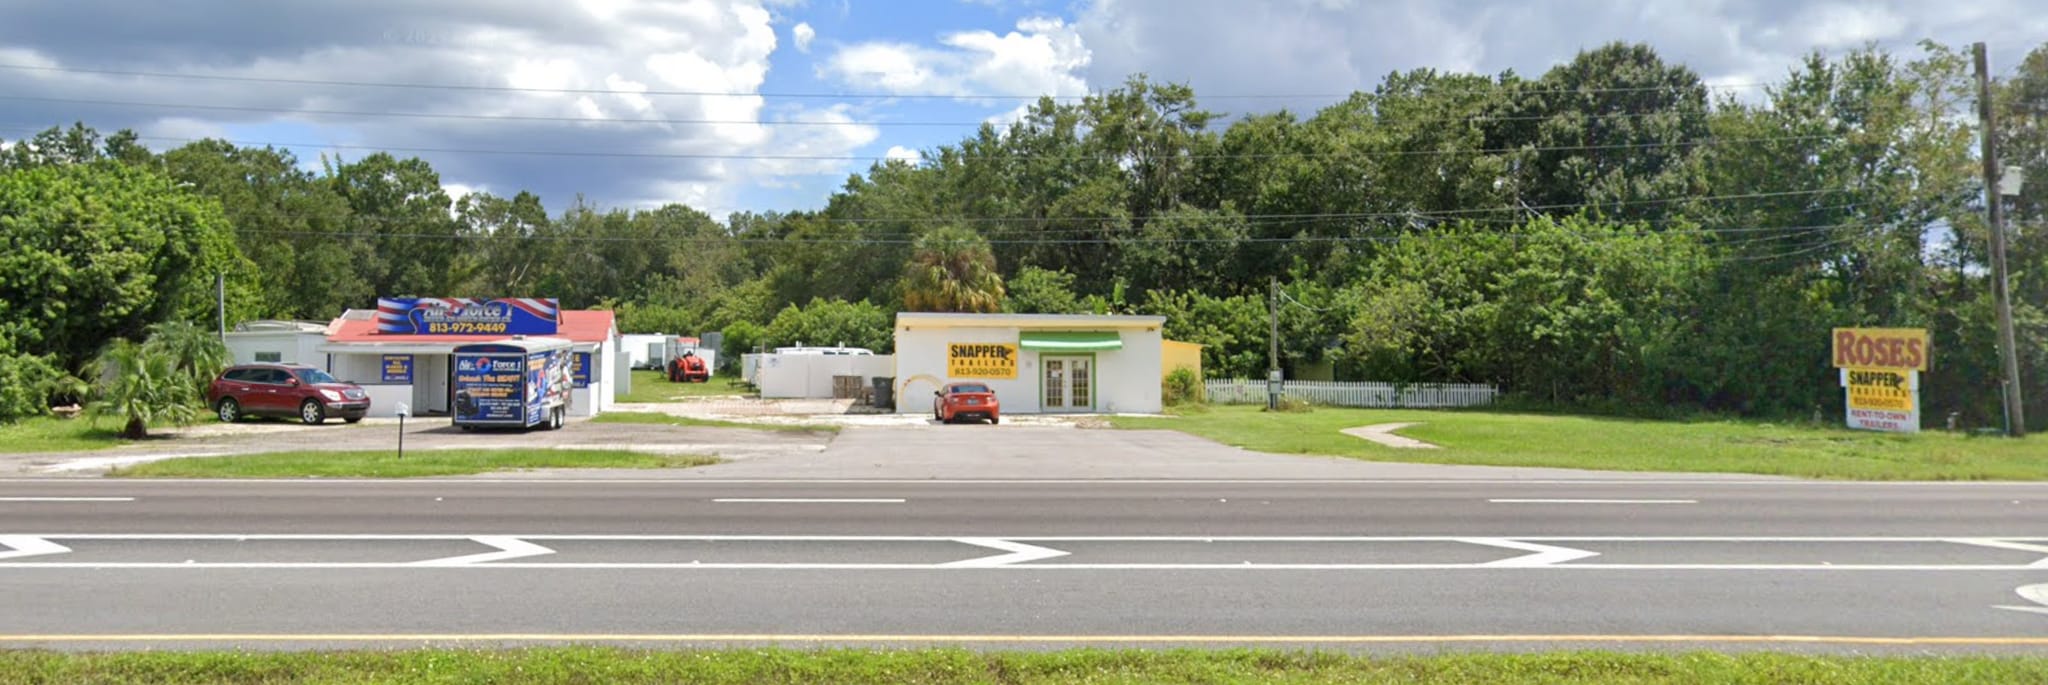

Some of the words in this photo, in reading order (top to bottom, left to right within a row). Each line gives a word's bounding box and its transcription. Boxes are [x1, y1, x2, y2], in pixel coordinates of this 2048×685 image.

[429, 322, 506, 333] 813-972-9449
[951, 345, 1005, 358] SNAPPER
[1836, 331, 1922, 368] ROSES
[1849, 371, 1897, 387] SNAPPER
